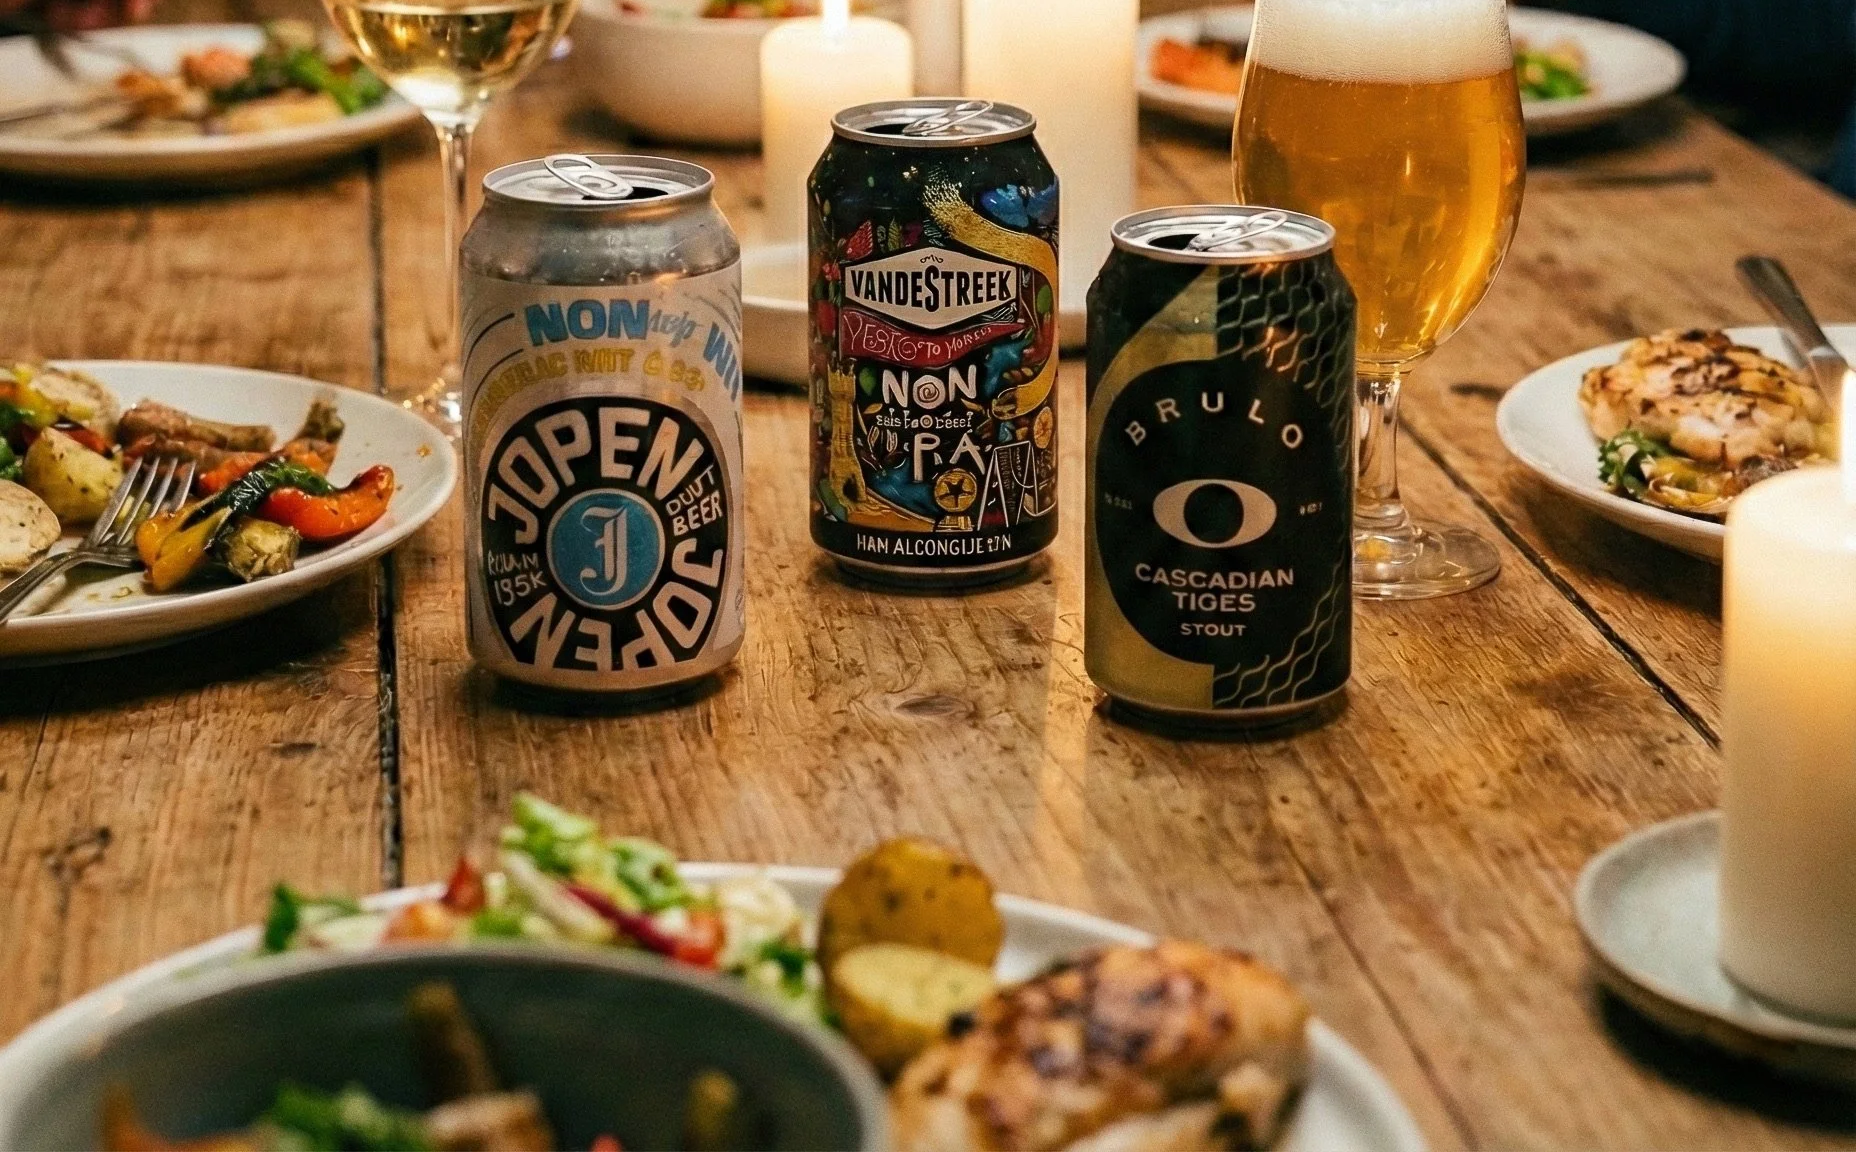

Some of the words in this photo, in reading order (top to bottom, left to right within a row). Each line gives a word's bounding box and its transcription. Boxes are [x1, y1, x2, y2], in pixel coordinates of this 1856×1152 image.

[850, 264, 1012, 313] VANDESTREEK
[525, 299, 650, 347] NON
[882, 364, 978, 410] NON
[1125, 391, 1304, 450] BRULO
[488, 407, 705, 544] JOPEN
[672, 489, 723, 537] BEER
[1135, 562, 1295, 590] CASCADIAN
[509, 537, 724, 672] JOPEN
[1171, 591, 1257, 613] TIGES
[1180, 623, 1248, 637] STOUT
